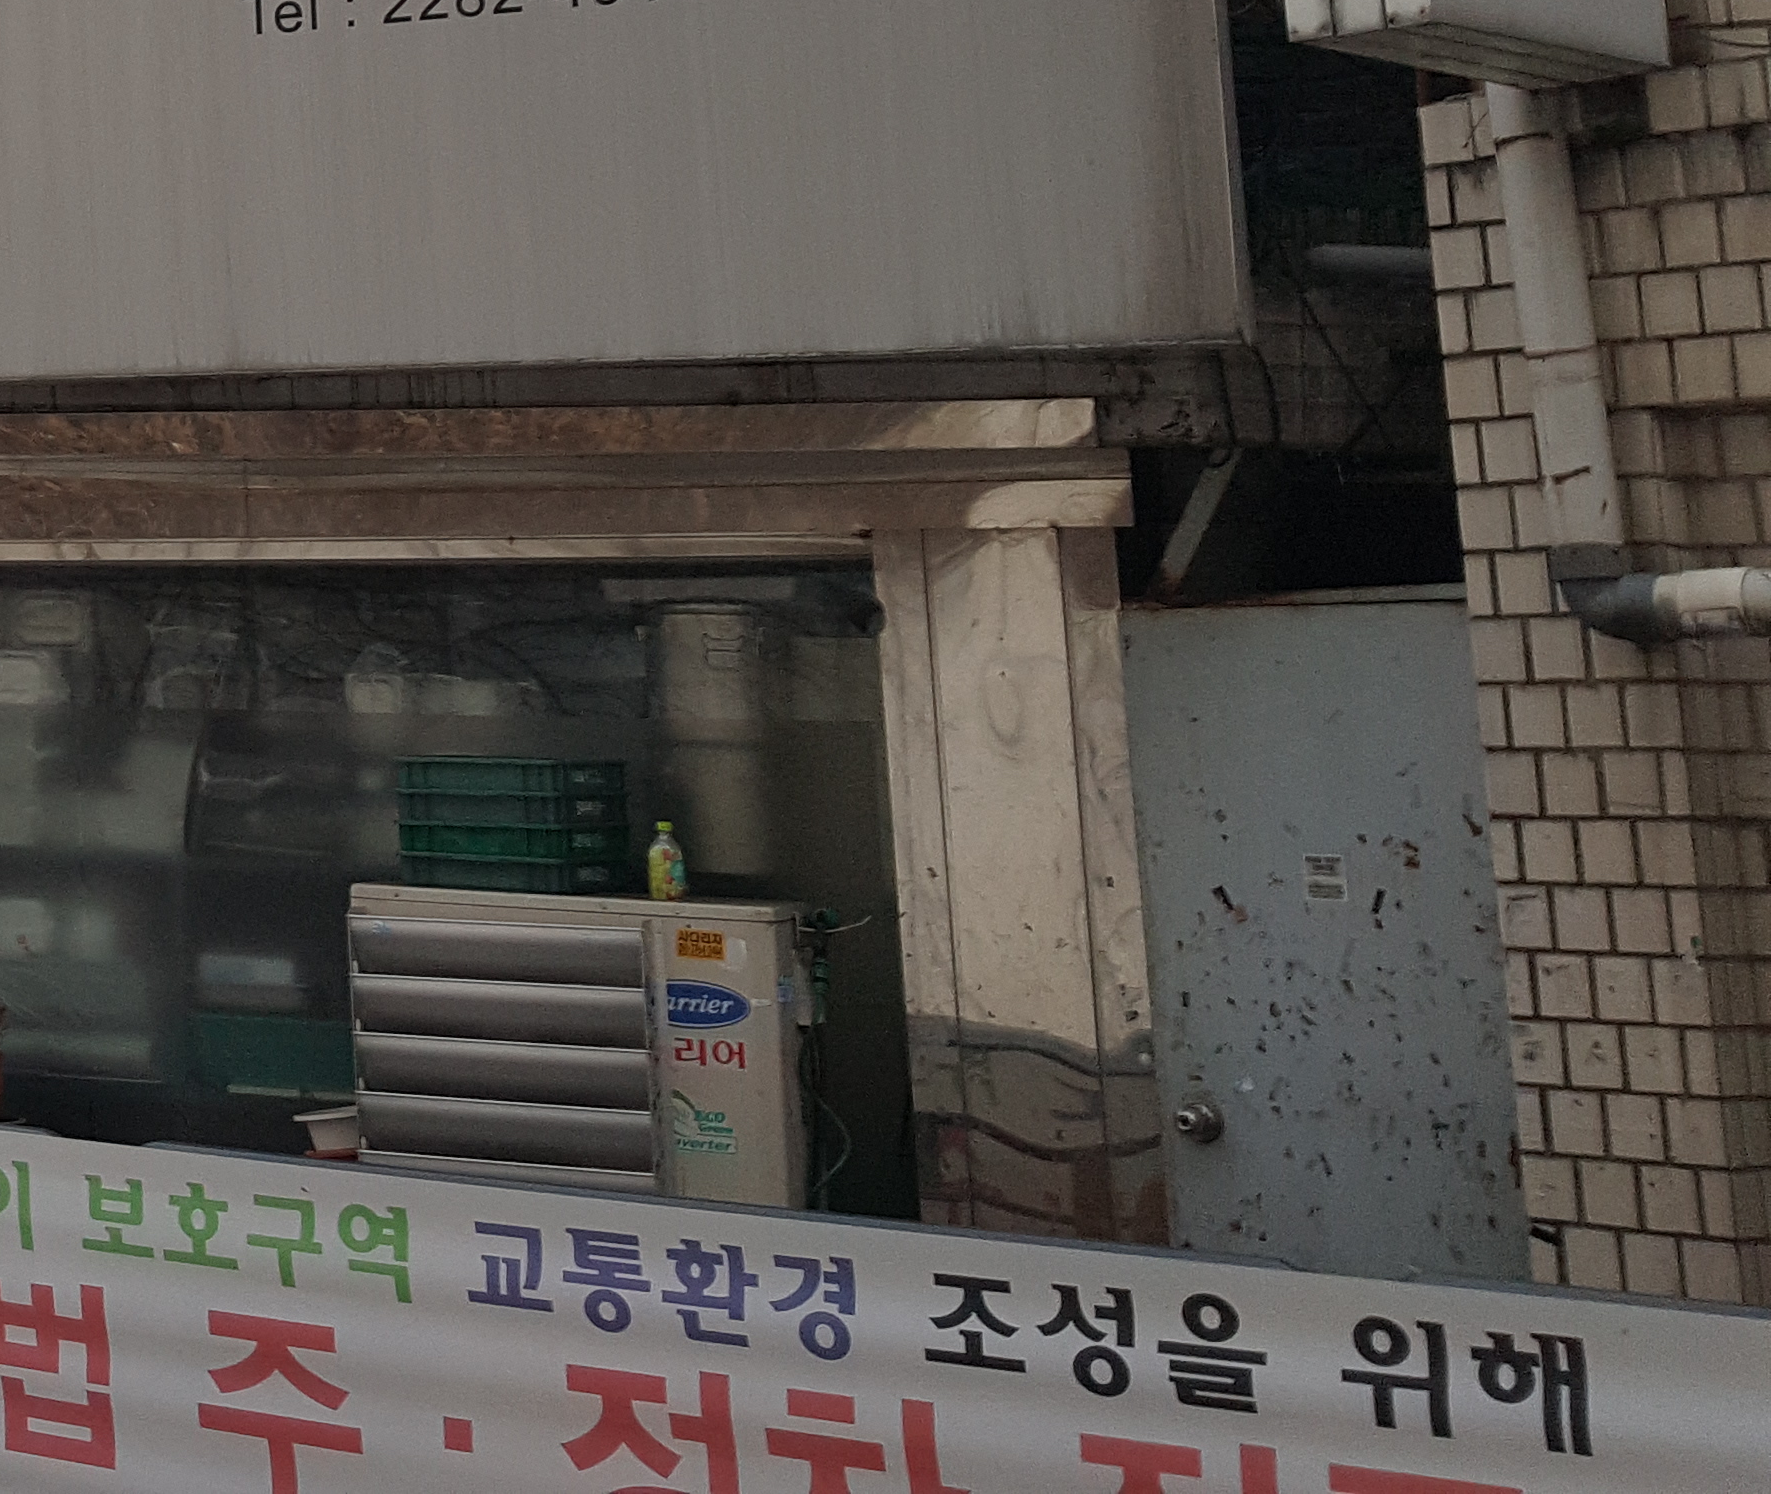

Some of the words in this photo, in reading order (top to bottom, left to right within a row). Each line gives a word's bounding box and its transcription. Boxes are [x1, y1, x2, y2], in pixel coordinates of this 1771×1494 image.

[667, 993, 734, 1015] arrier
[673, 1037, 747, 1070] 리어
[81, 1174, 415, 1304] 보호구역
[466, 1221, 859, 1363] 교통환경
[923, 1271, 1269, 1416] 조성을
[1340, 1315, 1595, 1458] 위해
